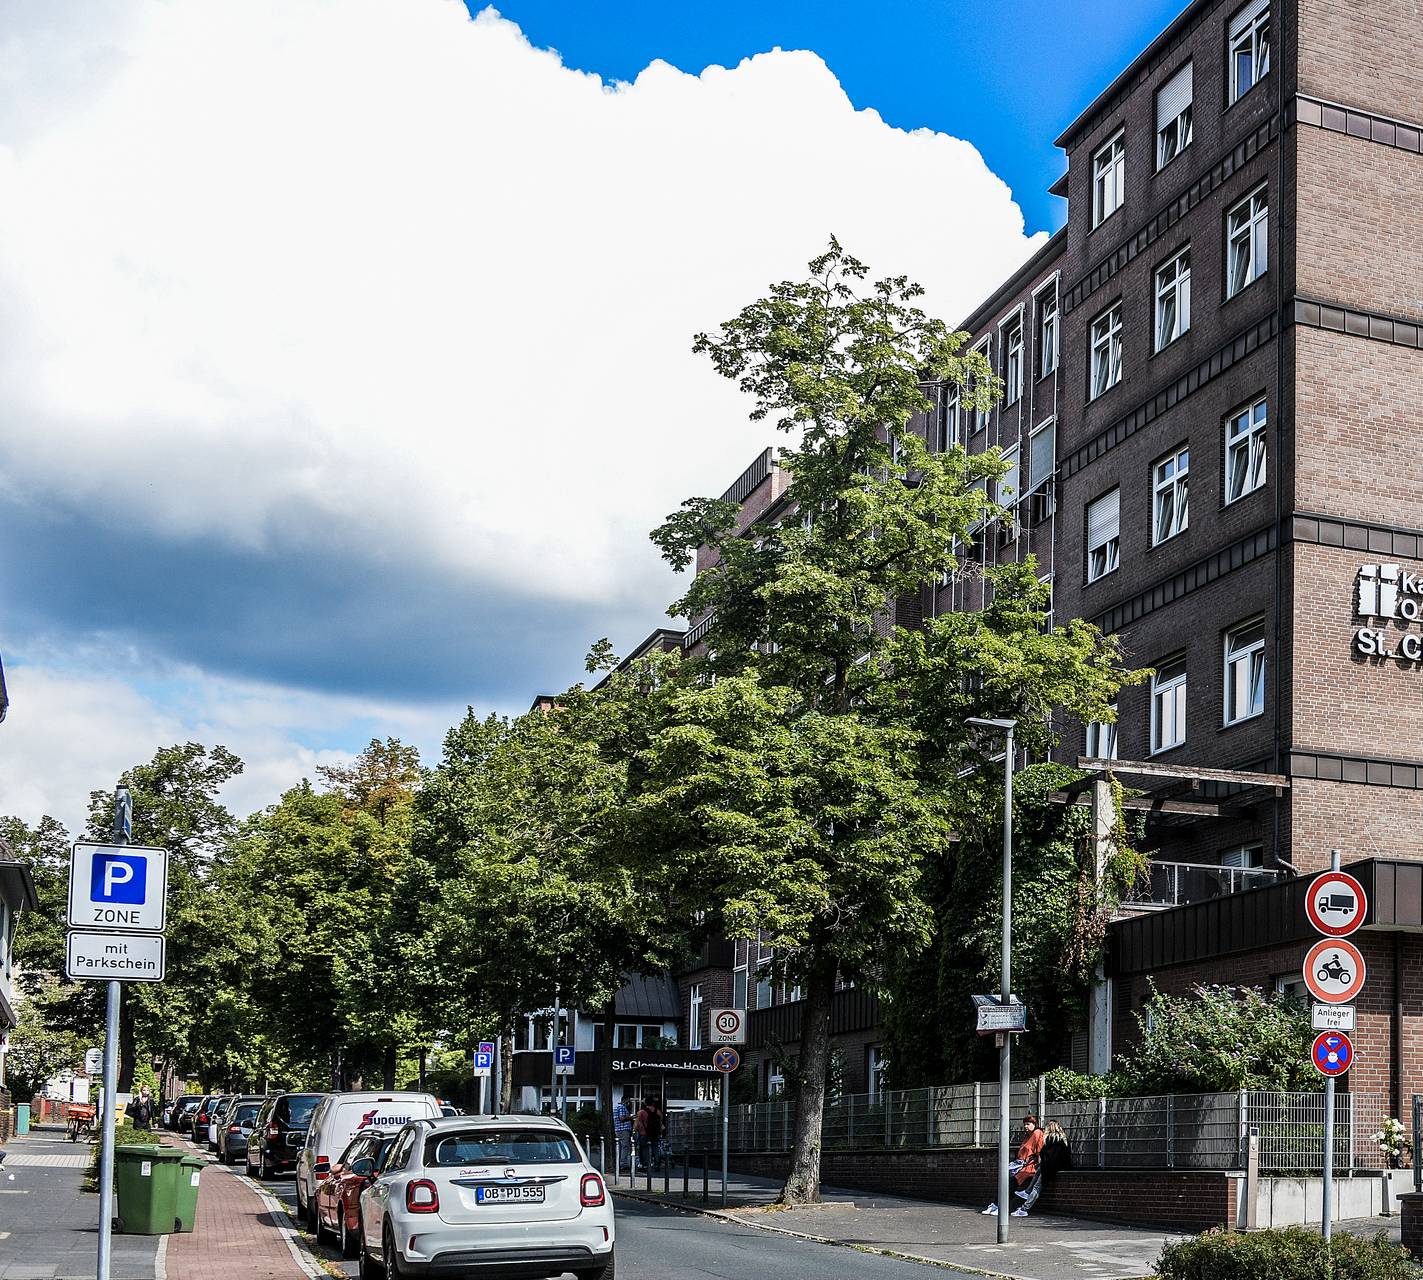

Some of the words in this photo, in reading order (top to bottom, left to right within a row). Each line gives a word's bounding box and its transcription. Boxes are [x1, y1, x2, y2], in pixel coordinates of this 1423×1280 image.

[1358, 628, 1393, 658] St.
[104, 861, 134, 896] P
[94, 909, 141, 924] ZONE
[105, 943, 128, 954] mit
[76, 956, 156, 970] Parkschein
[1317, 1009, 1350, 1018] Anlieger
[720, 1017, 735, 1028] 30
[478, 1055, 487, 1066] P
[560, 1048, 570, 1062] P
[485, 1188, 500, 1198] OB
[506, 1187, 521, 1198] PD
[523, 1187, 543, 1197] 555
